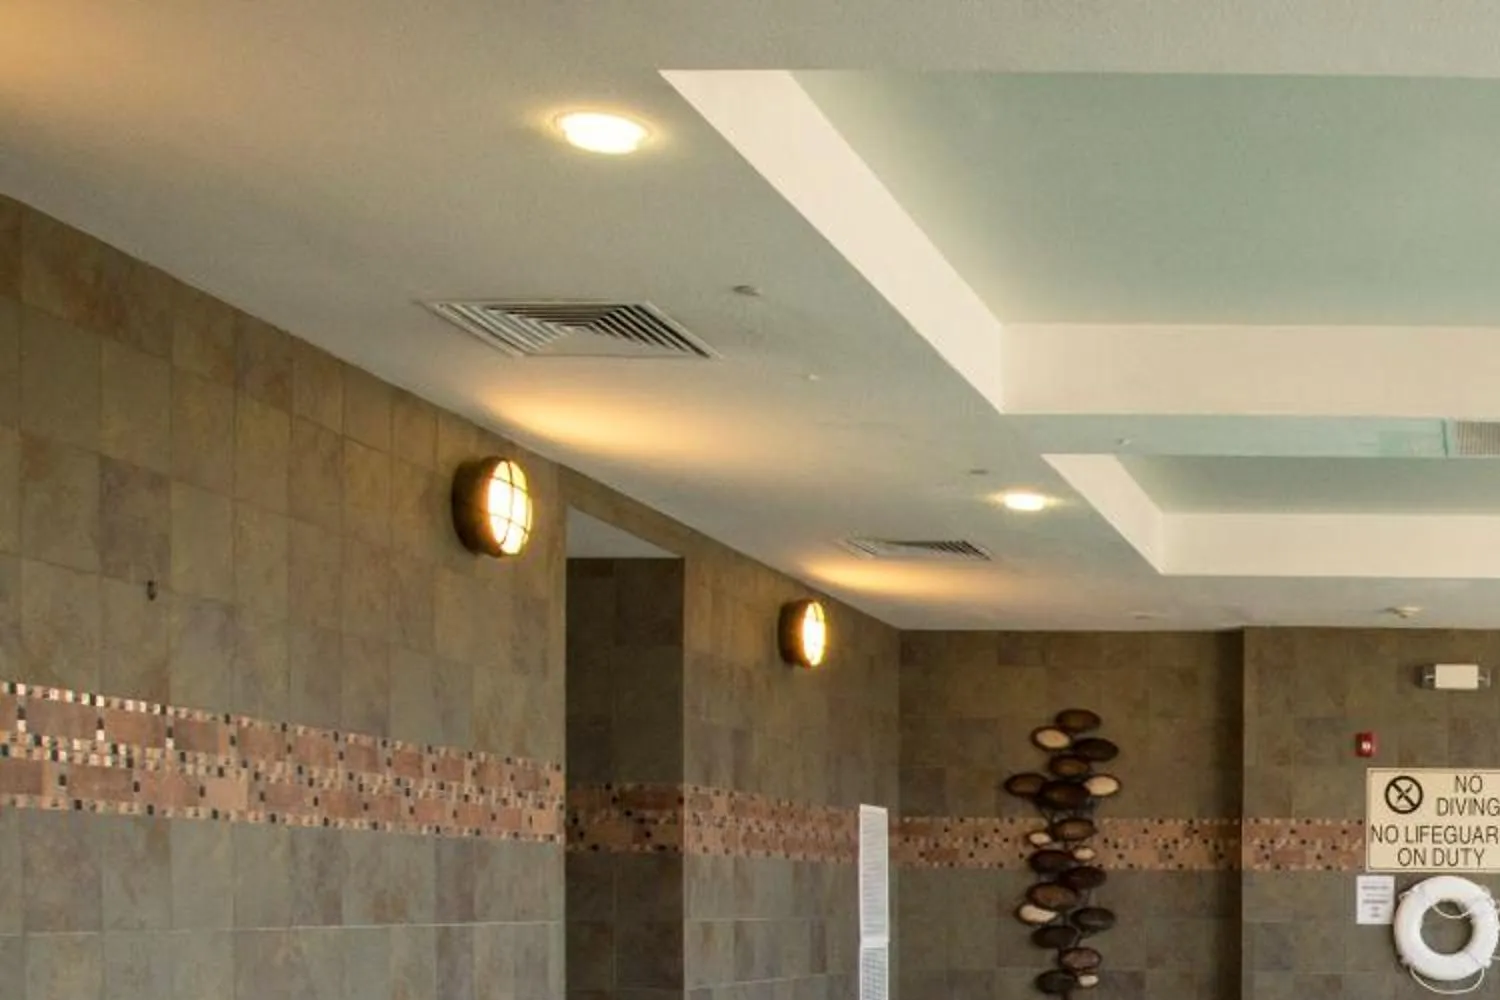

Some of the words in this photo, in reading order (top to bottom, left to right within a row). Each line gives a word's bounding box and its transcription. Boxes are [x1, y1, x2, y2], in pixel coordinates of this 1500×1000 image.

[1455, 775, 1483, 793] NO
[1436, 797, 1500, 816] DIVING
[1371, 824, 1399, 844] NO
[1397, 847, 1427, 867] ON
[1432, 848, 1485, 867] DUTY
